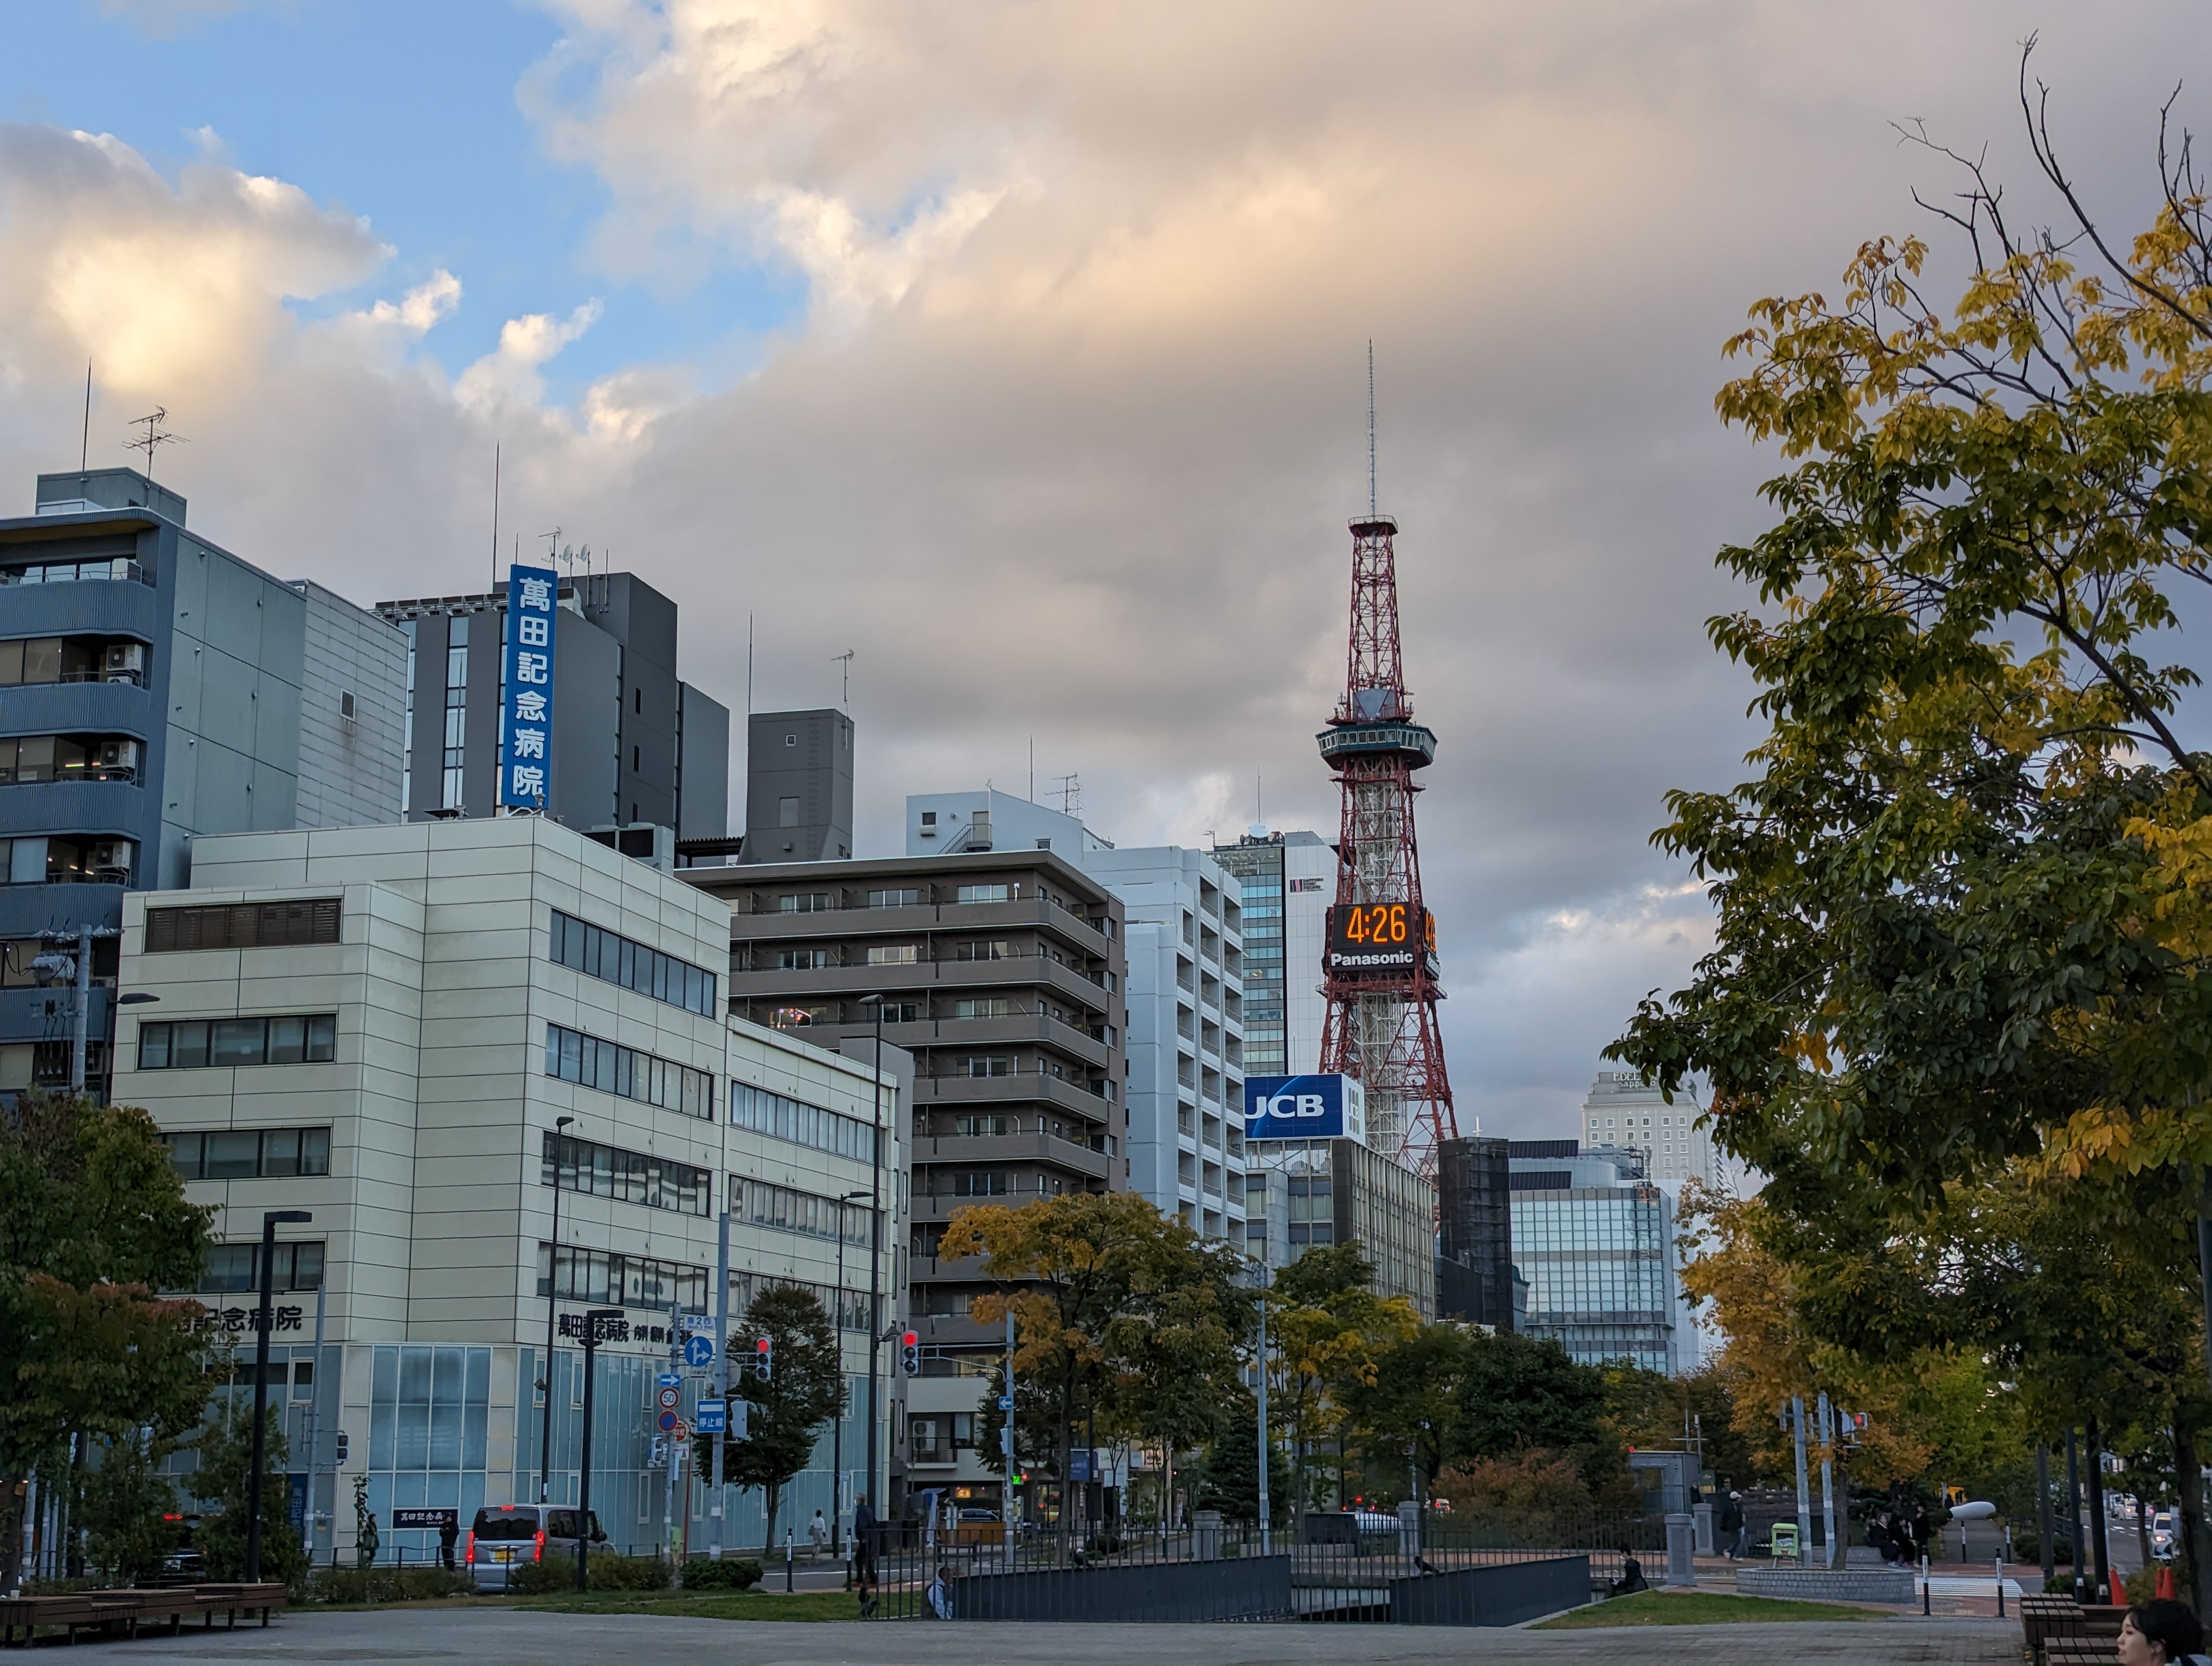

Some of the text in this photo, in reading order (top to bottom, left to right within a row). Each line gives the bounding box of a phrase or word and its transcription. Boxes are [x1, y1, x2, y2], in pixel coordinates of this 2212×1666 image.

[512, 576, 552, 796] 萬田記念病院
[1348, 906, 1405, 943] 4:26
[1330, 950, 1413, 966] Panasonic
[1245, 1094, 1324, 1119] JCB
[664, 1394, 674, 1403] 50
